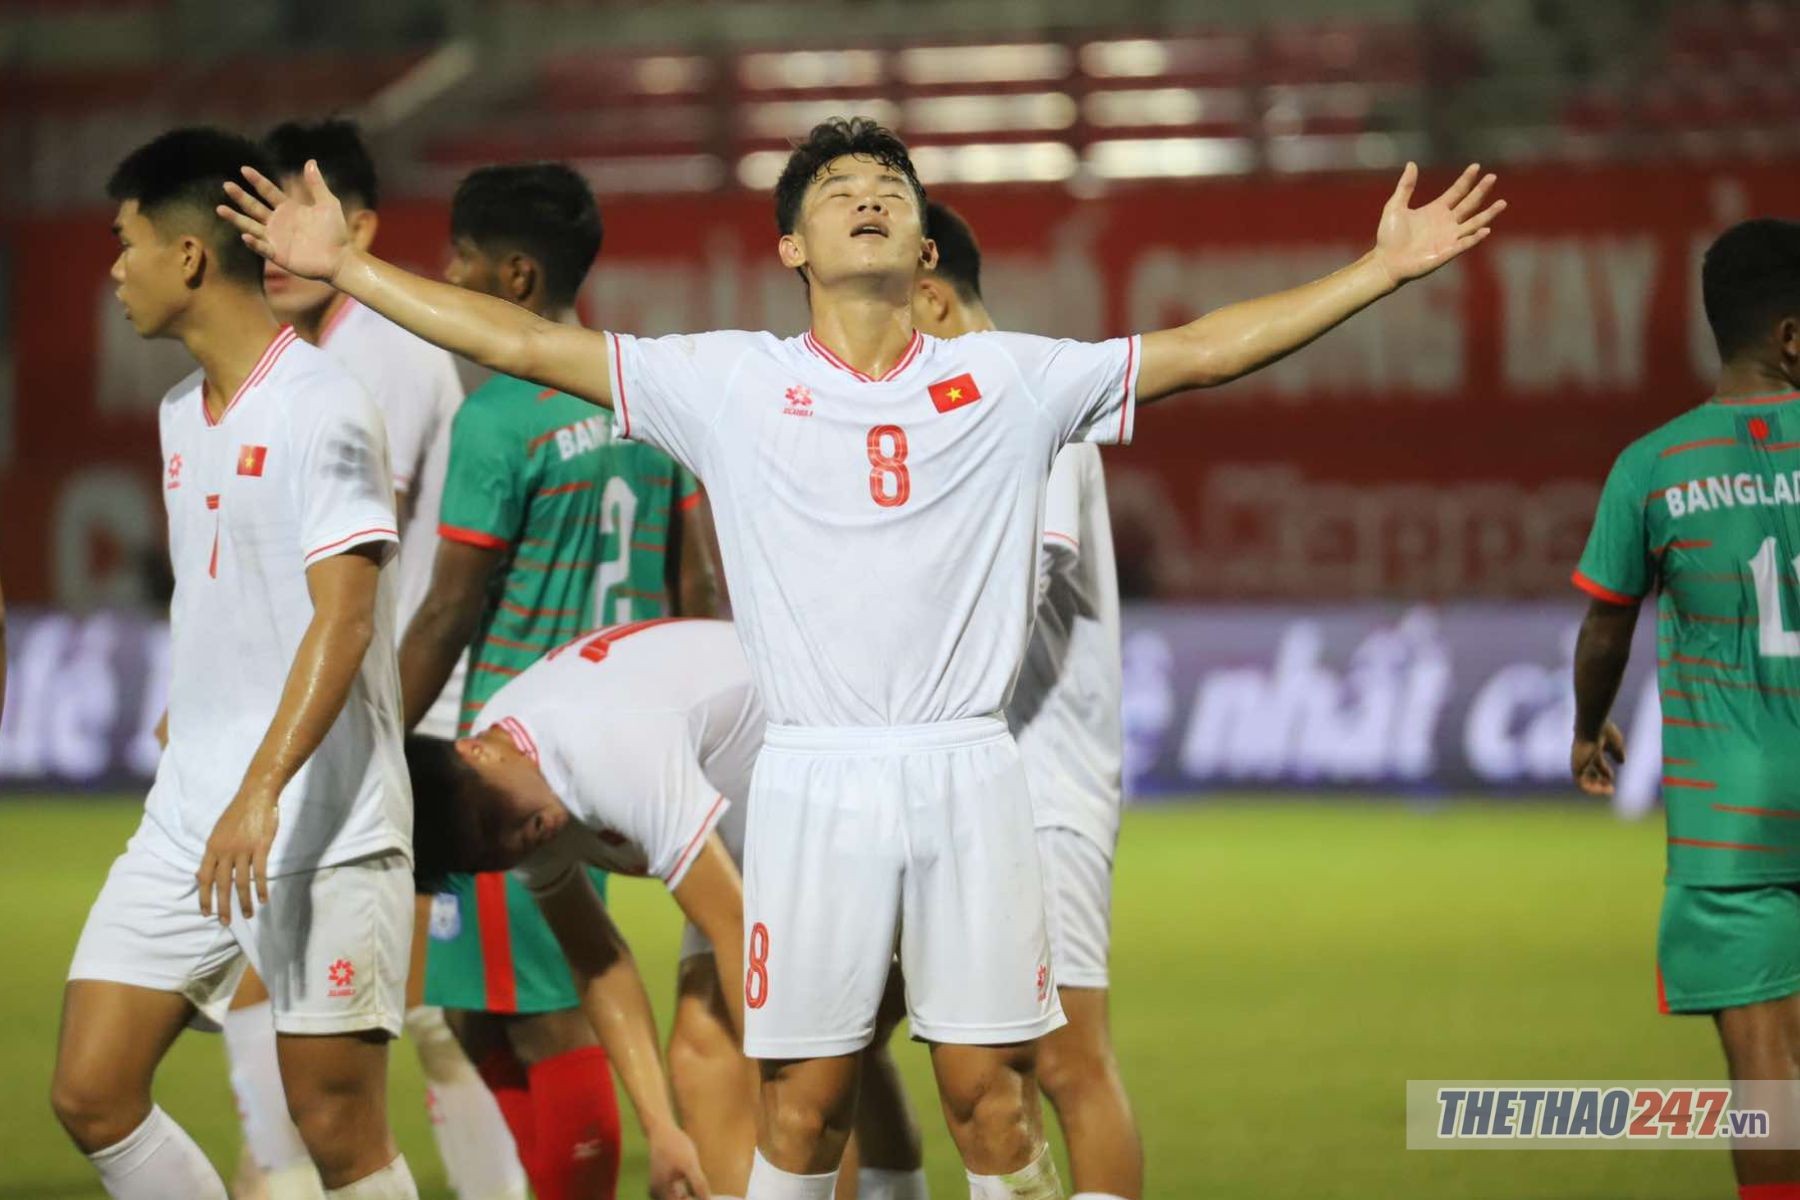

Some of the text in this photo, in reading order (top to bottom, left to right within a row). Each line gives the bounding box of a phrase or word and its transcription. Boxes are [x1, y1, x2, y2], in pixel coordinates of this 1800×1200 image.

[555, 414, 616, 461] BAN
[866, 424, 910, 508] 8
[592, 475, 638, 628] 2
[745, 922, 769, 1009] 8
